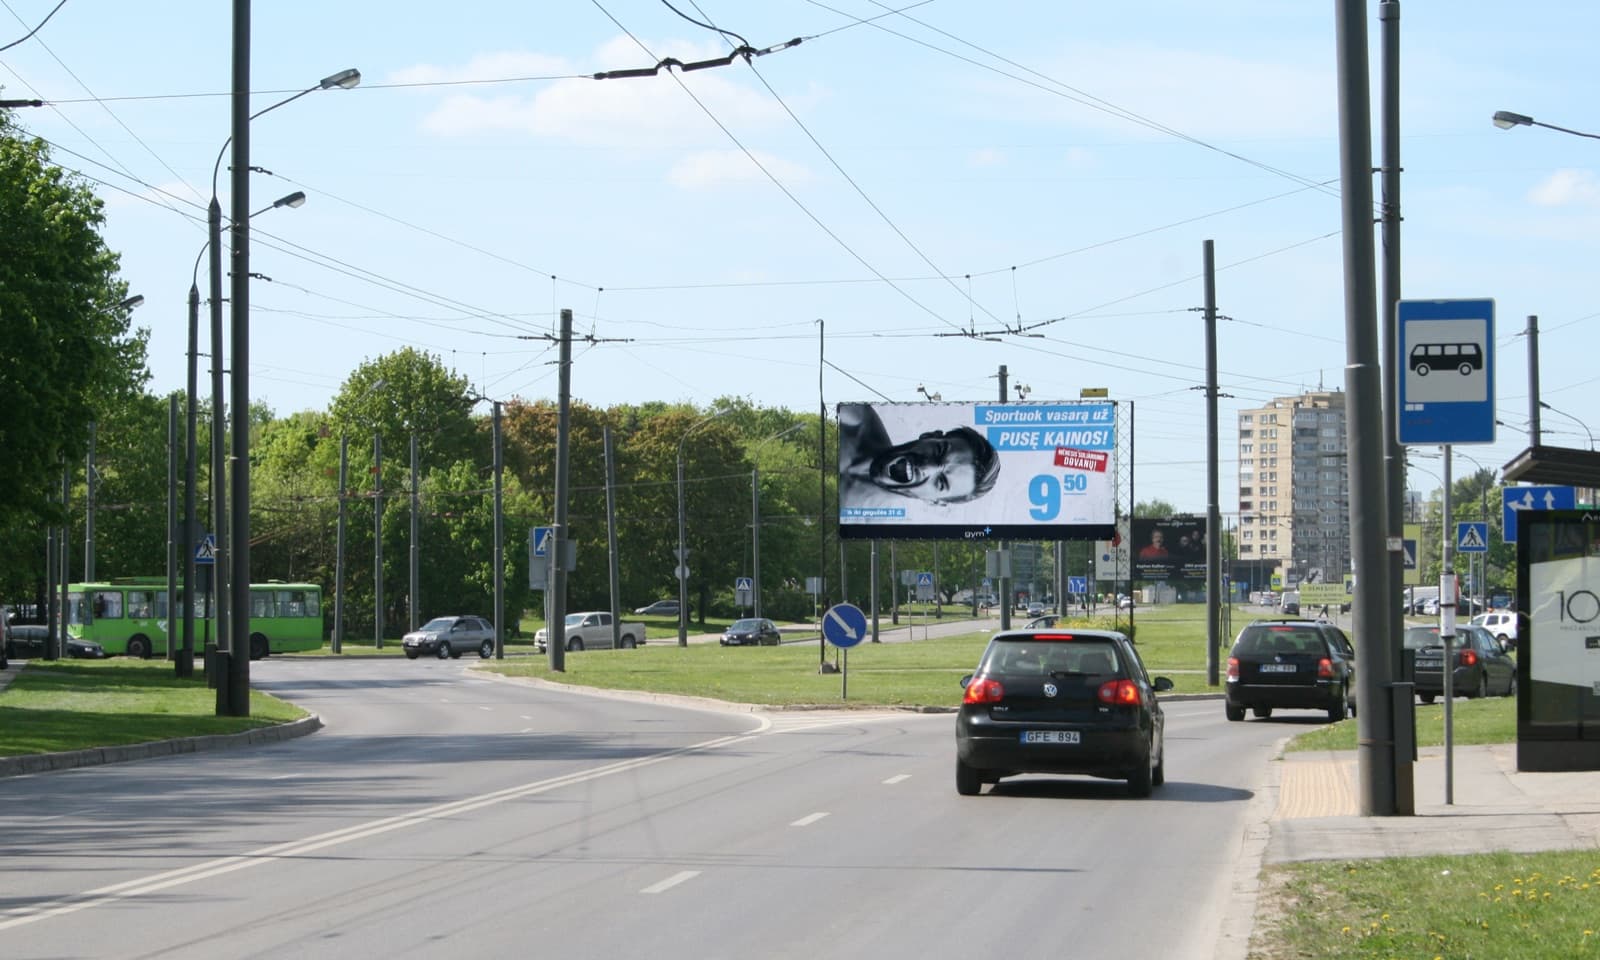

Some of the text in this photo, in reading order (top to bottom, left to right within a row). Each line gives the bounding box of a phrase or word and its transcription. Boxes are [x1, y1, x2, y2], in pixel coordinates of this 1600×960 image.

[985, 408, 1109, 424] Sportuok vasarą už
[999, 431, 1108, 449] PUSĘ KAINOS!
[1028, 473, 1088, 521] 9 50
[1026, 731, 1079, 743] GFE 894
